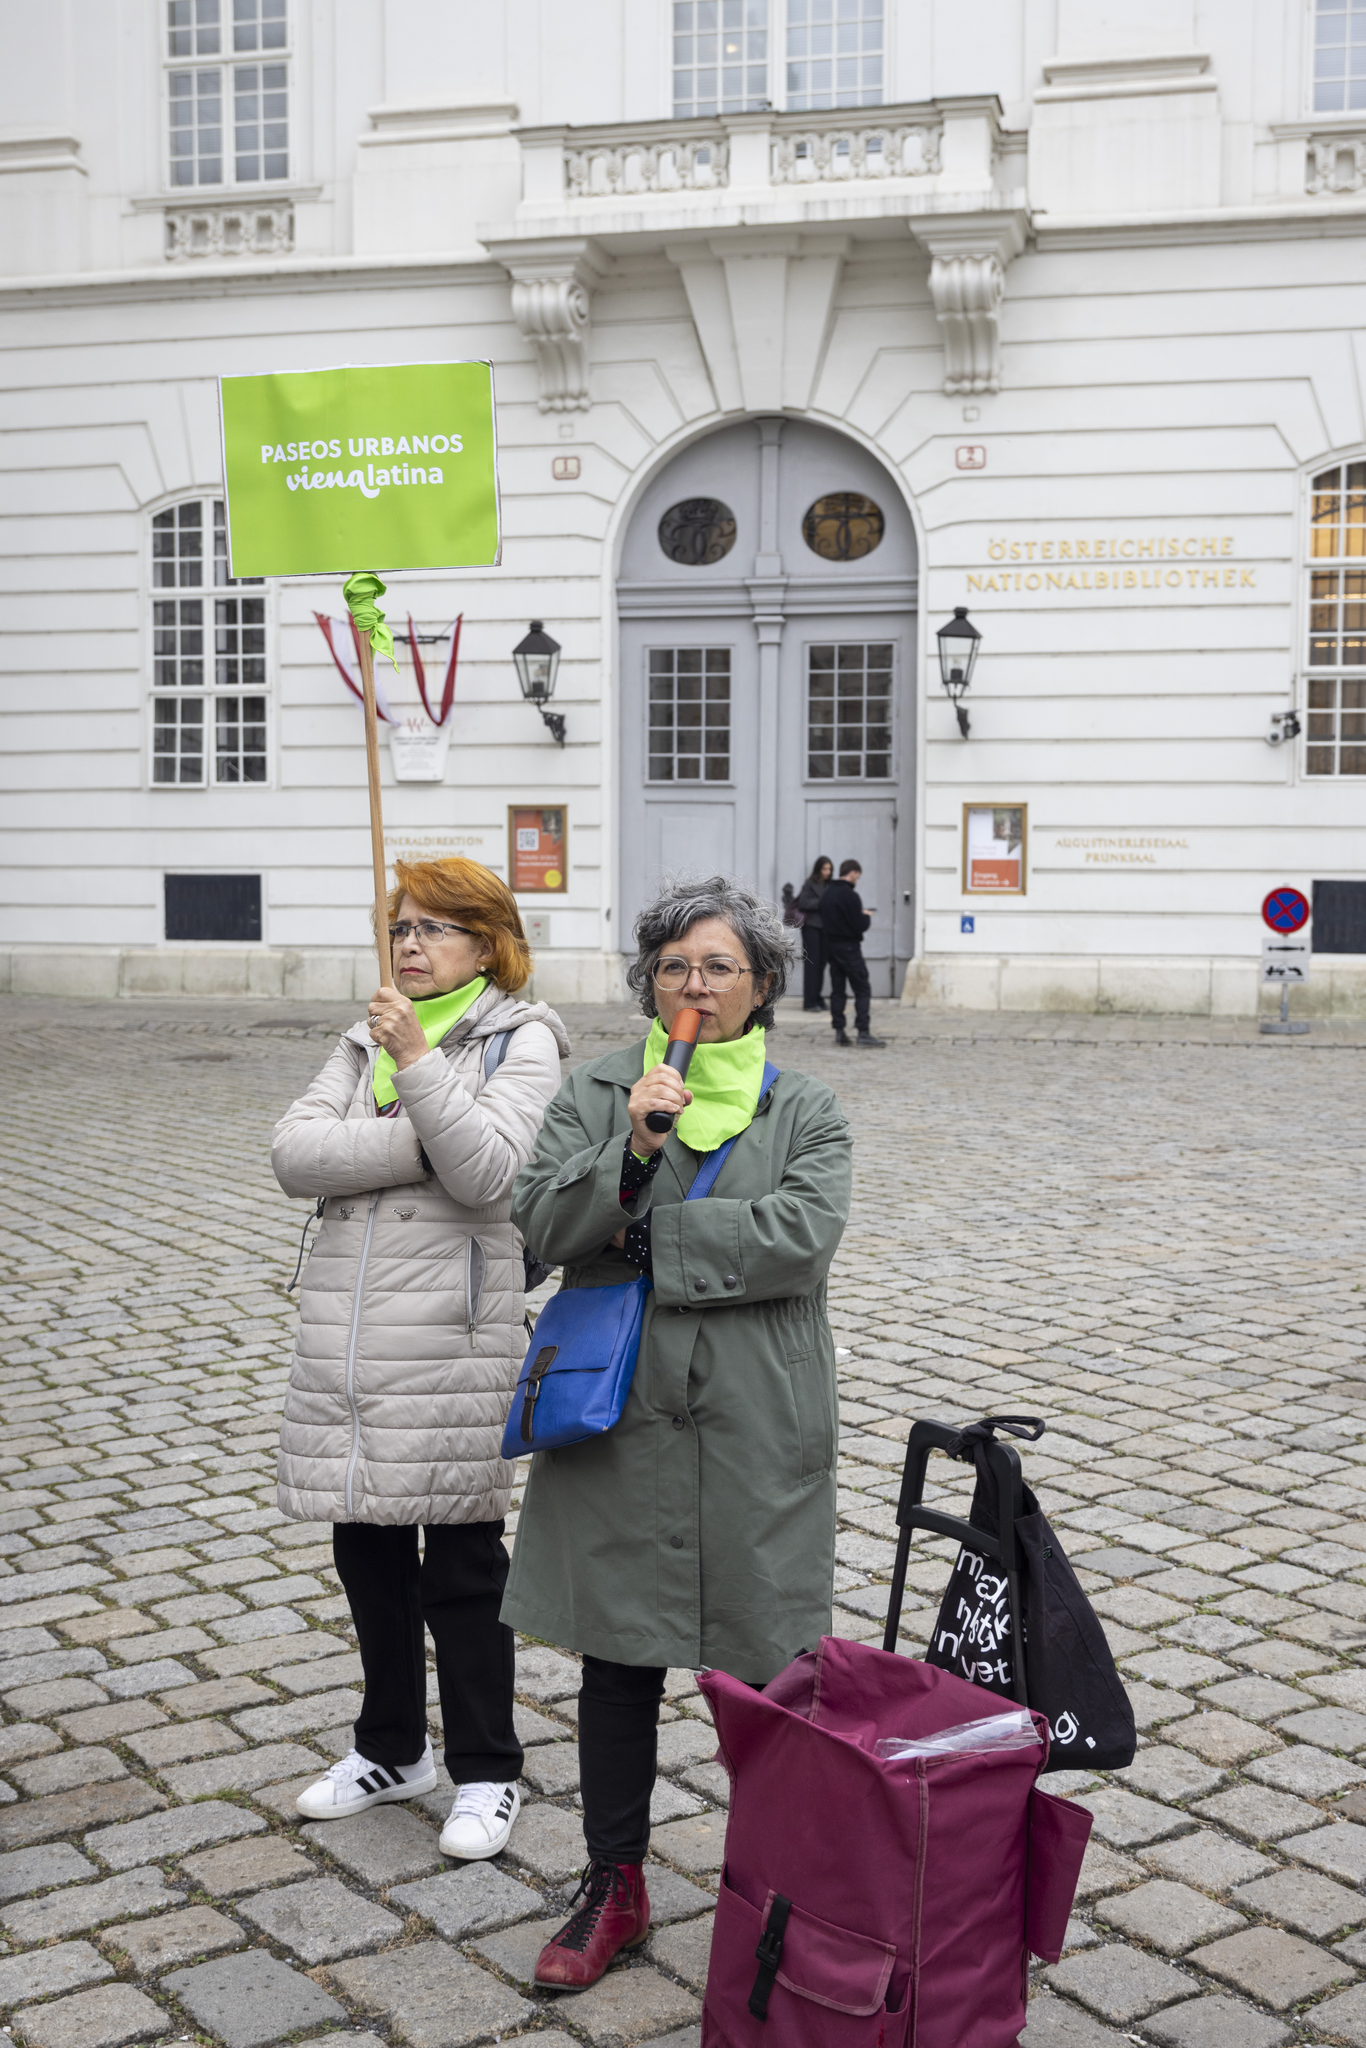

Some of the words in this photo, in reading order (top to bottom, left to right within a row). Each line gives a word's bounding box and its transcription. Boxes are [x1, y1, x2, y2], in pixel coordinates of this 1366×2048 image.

[261, 439, 342, 463] PASEOS
[348, 434, 463, 457] URBANOS
[988, 537, 1234, 560] ÖSTERREICHISCHE
[966, 569, 1256, 592] NATIONALBIBLIOTHEK
[384, 836, 484, 846] ENERALDIREKTION
[1055, 838, 1188, 849] AUGUSTINERLESESAAL
[1085, 852, 1156, 863] PRUNKSAAL
